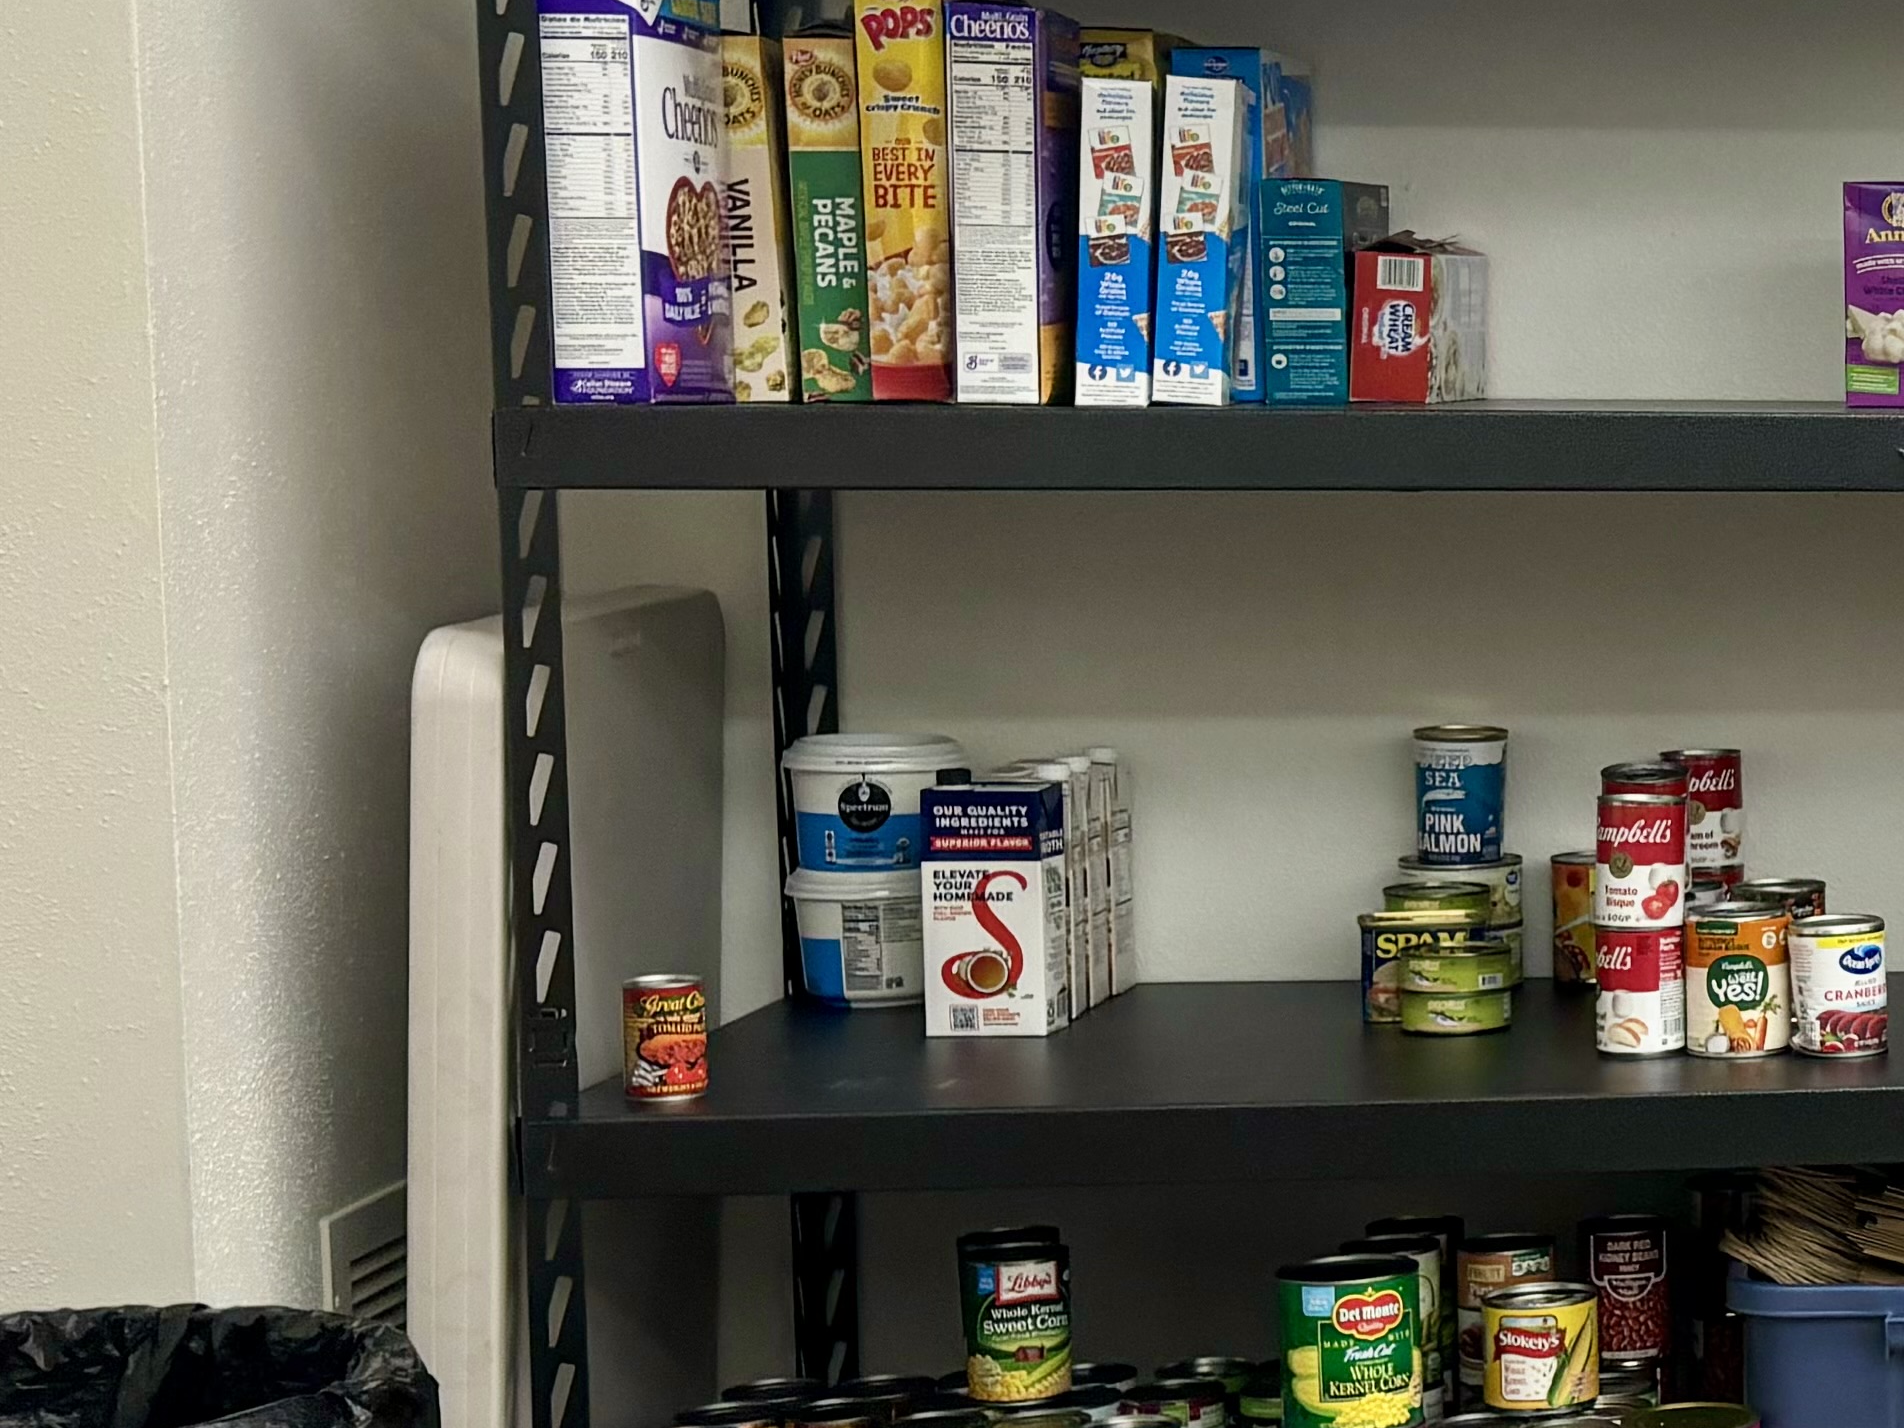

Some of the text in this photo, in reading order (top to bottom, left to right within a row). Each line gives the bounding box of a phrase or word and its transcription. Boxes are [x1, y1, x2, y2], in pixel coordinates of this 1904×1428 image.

[860, 6, 935, 52] POPS
[950, 14, 1030, 40] Cheerios
[873, 148, 935, 161] BEST IN
[874, 163, 935, 182] EVERY
[875, 184, 937, 209] BITE
[725, 178, 758, 292] VANILLA
[812, 198, 837, 287] PECANS
[835, 198, 856, 275] MAPLE
[1390, 303, 1401, 352] WHEAT
[1402, 303, 1415, 353] CREAM
[1425, 773, 1462, 786] SEA
[933, 806, 1028, 816] OUR QUALITY
[936, 817, 1028, 828] INGREDIENTS
[1426, 814, 1465, 833] PINK
[933, 870, 990, 880] ELEVATE
[933, 880, 972, 890] YOUR
[933, 892, 1013, 902] HOMEMADE
[1712, 971, 1764, 1002] Yes!
[1607, 1240, 1650, 1251] DARK RED
[1600, 1251, 1628, 1263] KIDNEY
[1007, 1272, 1052, 1293] Libby's
[991, 1302, 1063, 1320] Whole Kernel
[1339, 1302, 1399, 1322] Del Monte
[984, 1314, 1068, 1335] Sweet Corn
